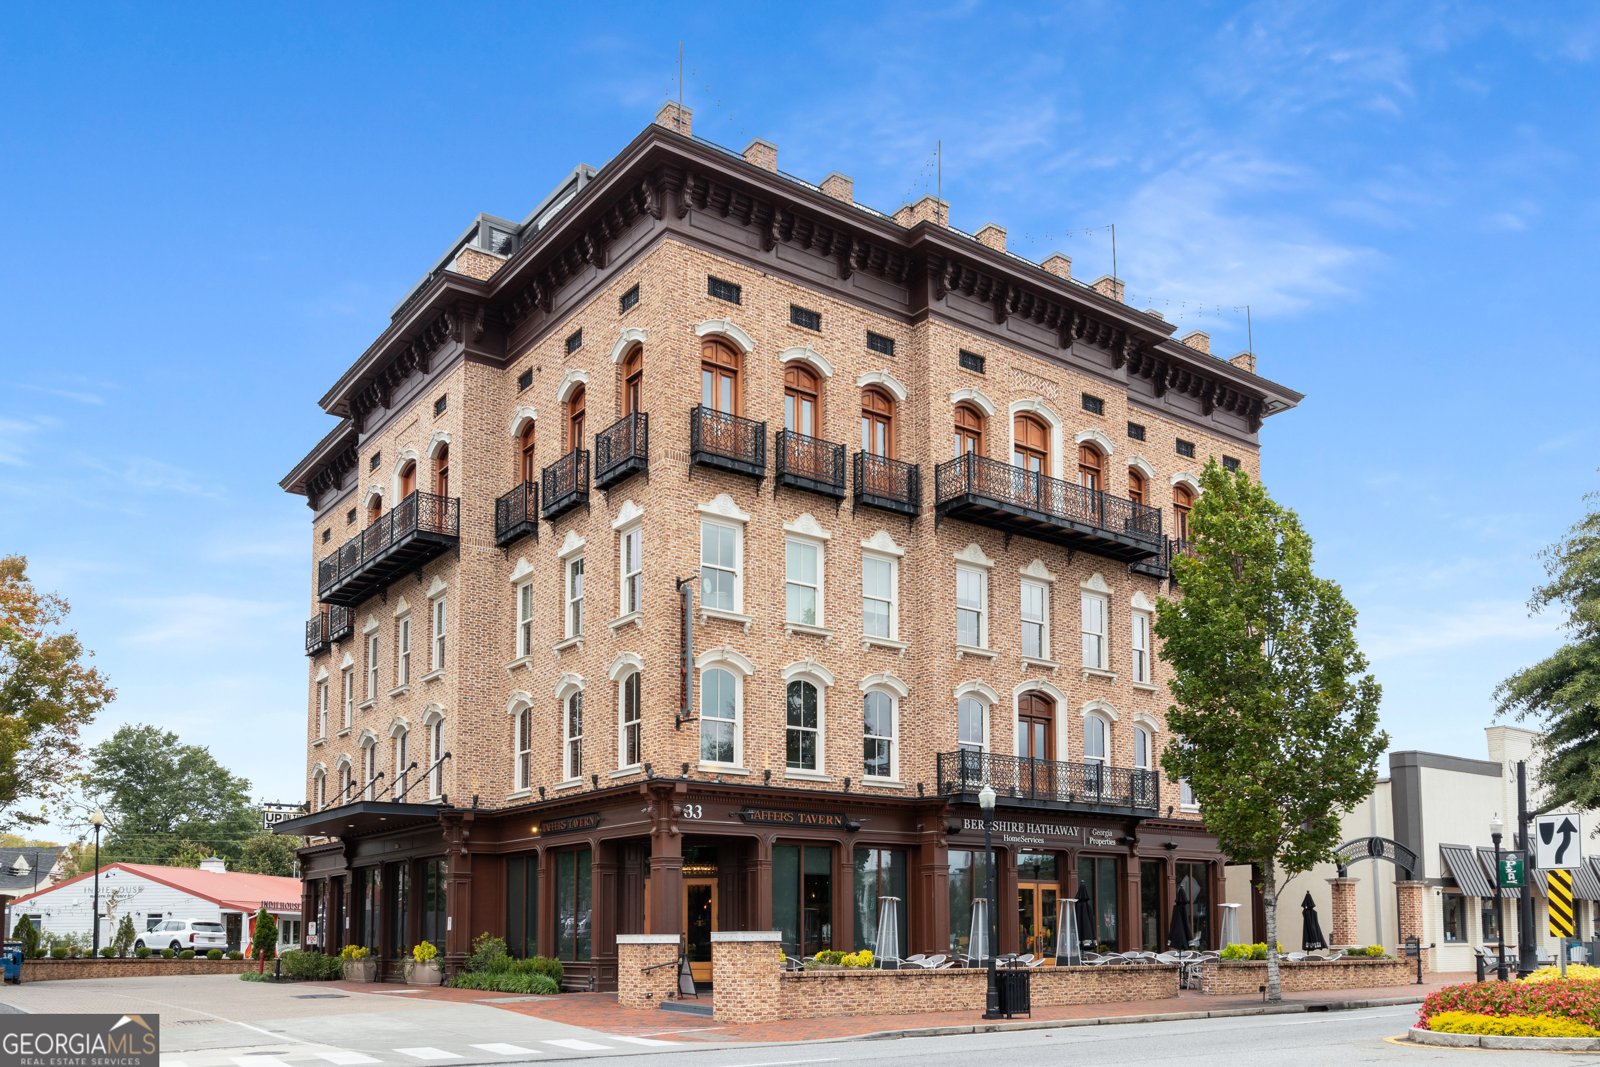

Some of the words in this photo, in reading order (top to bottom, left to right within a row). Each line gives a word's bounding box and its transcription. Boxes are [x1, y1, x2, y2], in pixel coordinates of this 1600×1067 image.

[683, 804, 703, 819] 33
[266, 813, 282, 822] UP
[798, 814, 842, 825] TAVERN
[963, 818, 1025, 833] BERSHIRE
[1026, 823, 1080, 837] HATHAWAY
[1091, 828, 1113, 838] Georgia
[1003, 834, 1045, 844] HomeServices
[1089, 837, 1116, 847] Properties
